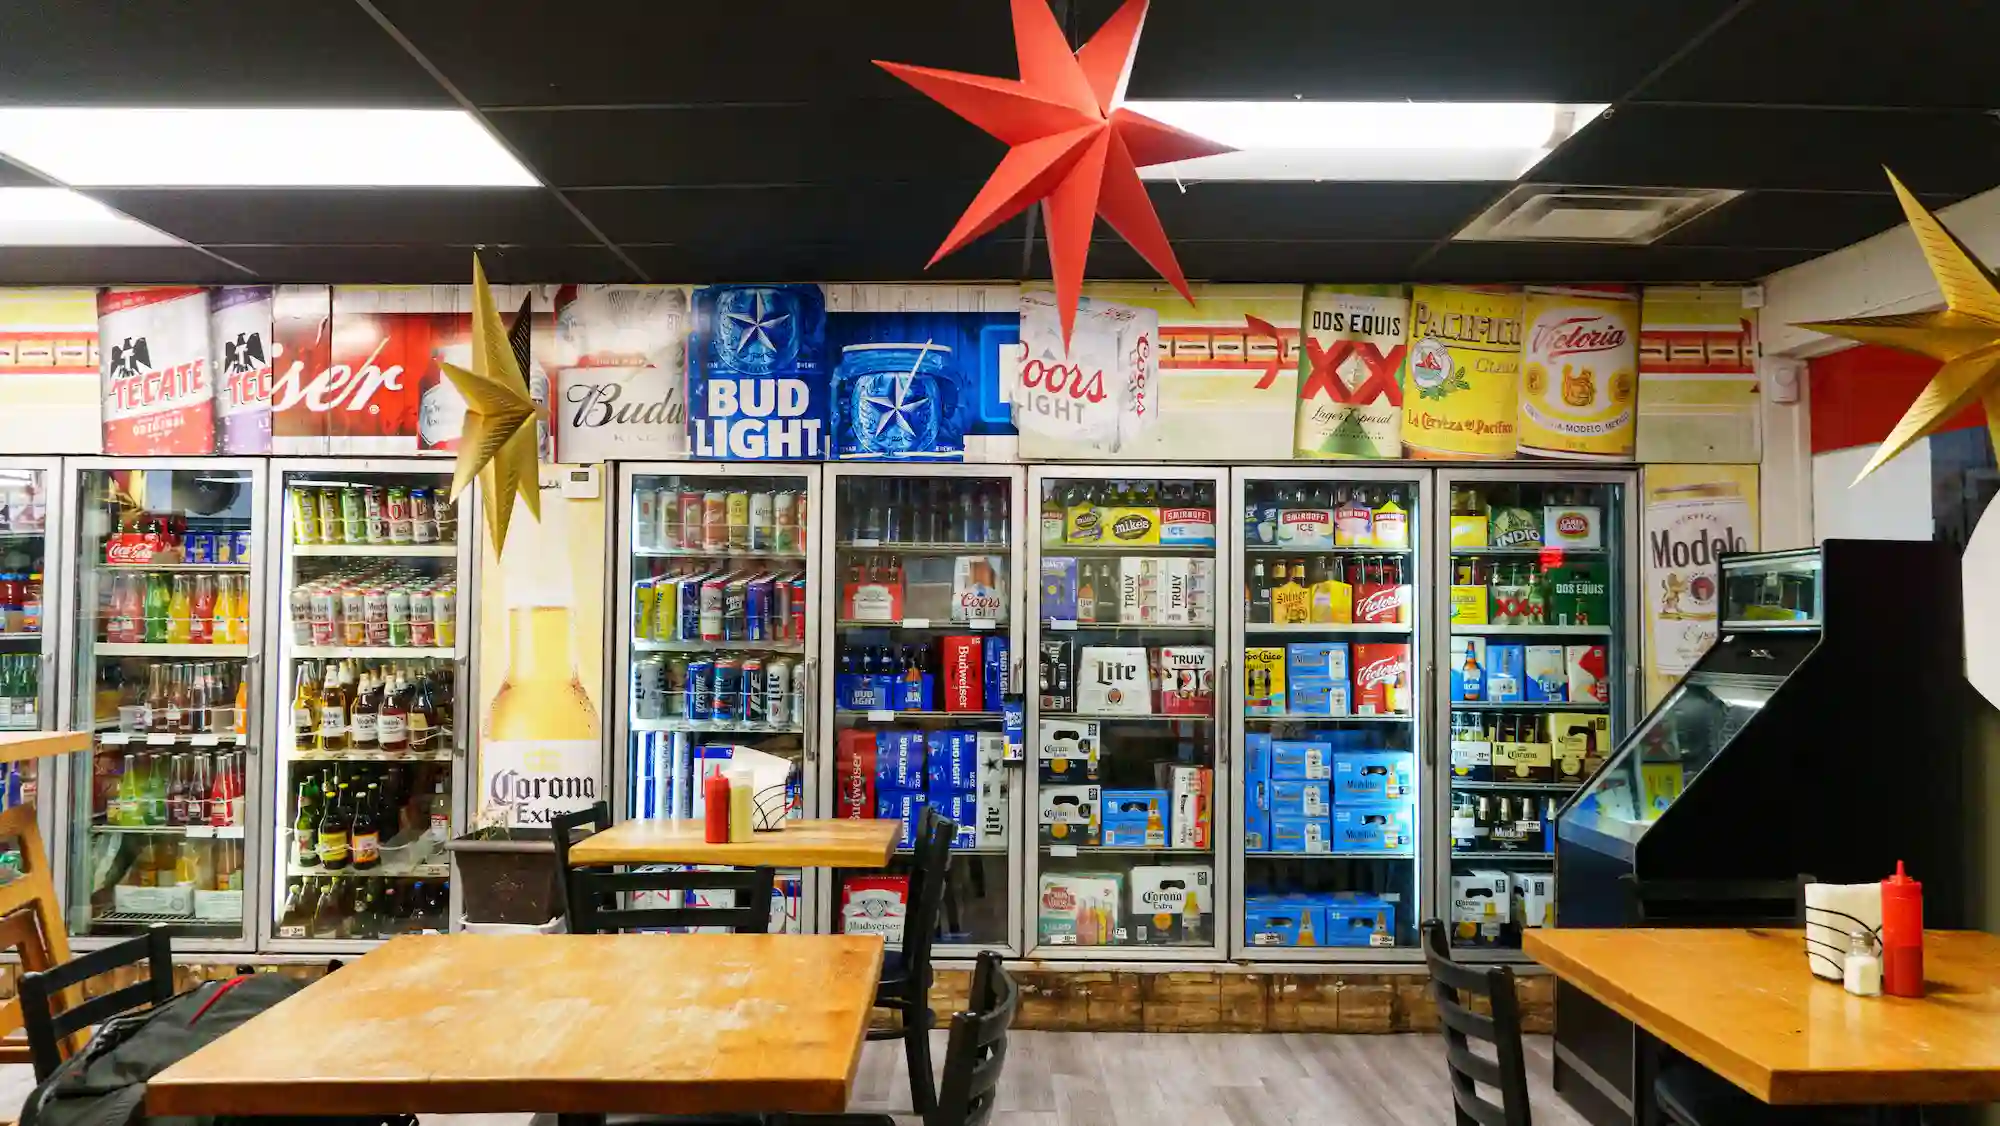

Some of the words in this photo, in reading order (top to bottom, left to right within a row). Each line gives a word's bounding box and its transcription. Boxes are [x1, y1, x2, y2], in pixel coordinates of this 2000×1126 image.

[1313, 311, 1344, 332] DOS
[1349, 314, 1400, 336] EQUIS
[1531, 316, 1629, 358] Victoria
[1300, 337, 1407, 407] XX
[109, 358, 206, 411] TECATE
[707, 379, 810, 417] BUD
[1312, 405, 1348, 423] Lager
[1407, 409, 1420, 428] La
[1421, 411, 1463, 432] Cerveza
[695, 419, 822, 458] LIGHT
[1114, 518, 1150, 534] mike's
[1166, 510, 1207, 521] SMIRNOFF
[1167, 526, 1185, 536] ICE
[1296, 523, 1314, 532] ICE
[1495, 529, 1541, 548] INDIO
[961, 592, 1001, 608] Coors
[1124, 574, 1134, 608] TRULY
[1171, 575, 1181, 609] TRULY
[1556, 583, 1575, 594] DOS
[1576, 584, 1604, 595] EQUIS
[964, 607, 997, 617] LIGHT
[1171, 654, 1205, 665] TRULY
[1260, 650, 1283, 664] Chico
[957, 645, 970, 708] Budweiser
[1096, 660, 1137, 686] Lite
[768, 674, 783, 702] Lite
[490, 768, 596, 806] Corona
[985, 807, 1004, 836] Lite
[1142, 891, 1183, 903] Corona
[849, 920, 901, 933] Budweiser
